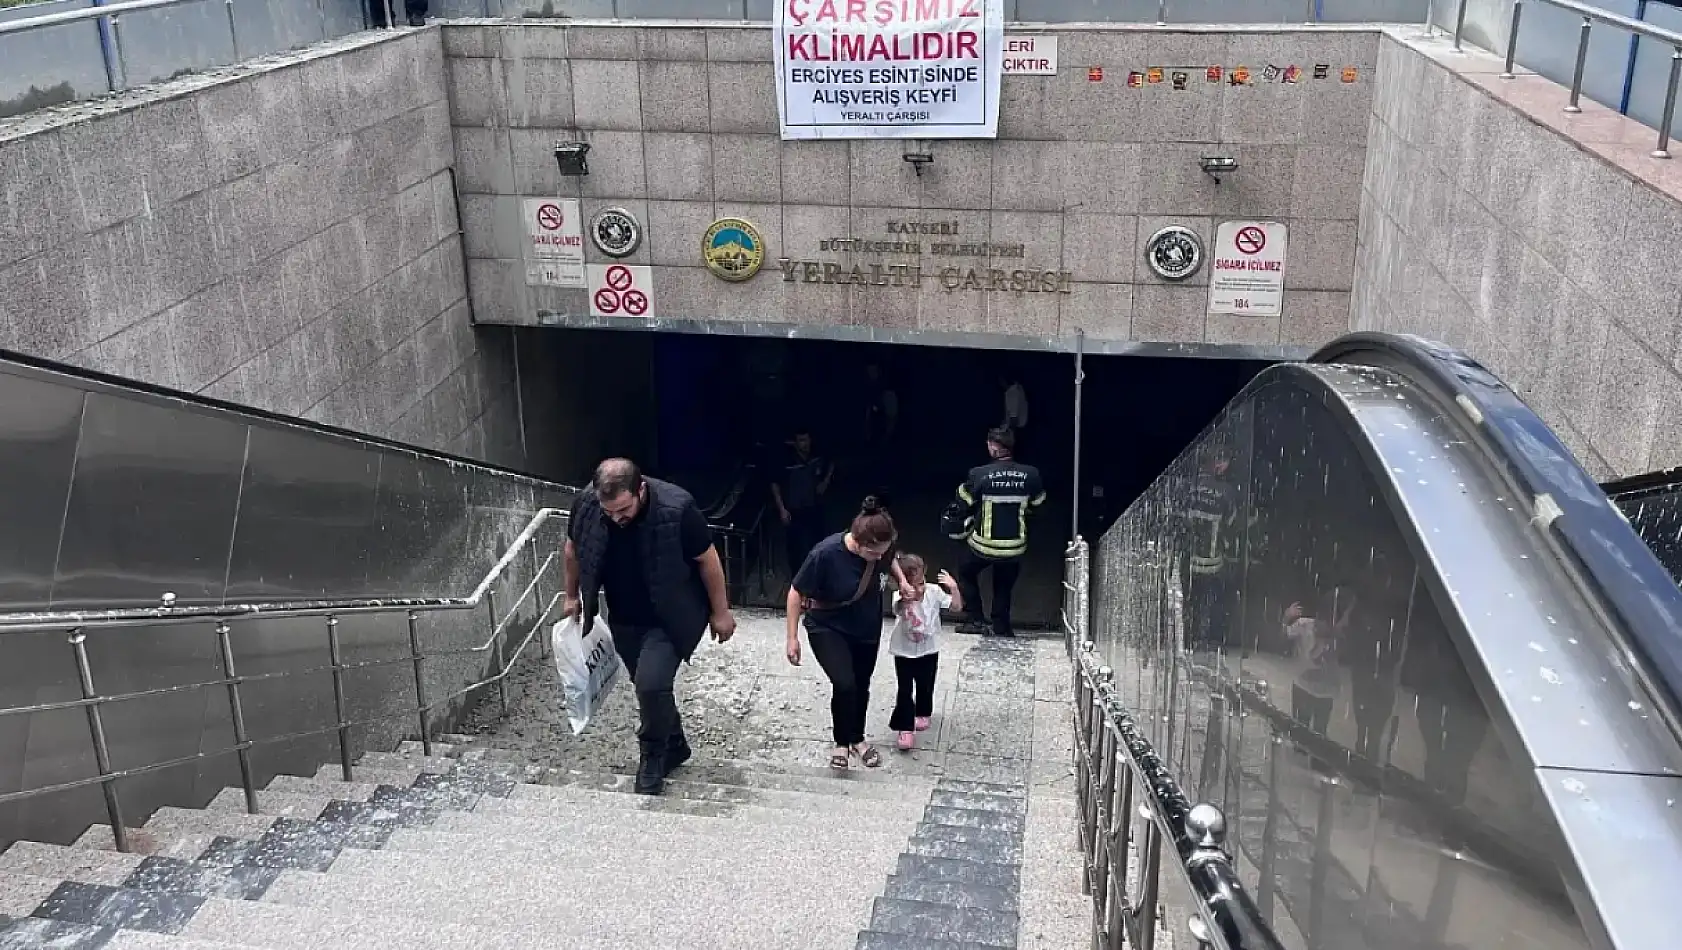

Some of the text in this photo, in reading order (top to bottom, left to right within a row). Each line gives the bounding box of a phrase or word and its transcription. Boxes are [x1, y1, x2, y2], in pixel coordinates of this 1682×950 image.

[789, 0, 979, 27] ÇARŞIMIZ
[789, 29, 979, 61] KLİMALIDIR
[792, 66, 863, 84] ERCİYES
[812, 85, 957, 107] ALIŞVERİŞ KEYFİ
[840, 111, 884, 121] YERALTI
[886, 220, 959, 235] KAYSERİ
[779, 258, 1072, 295] YERALTI ÇARŞISI
